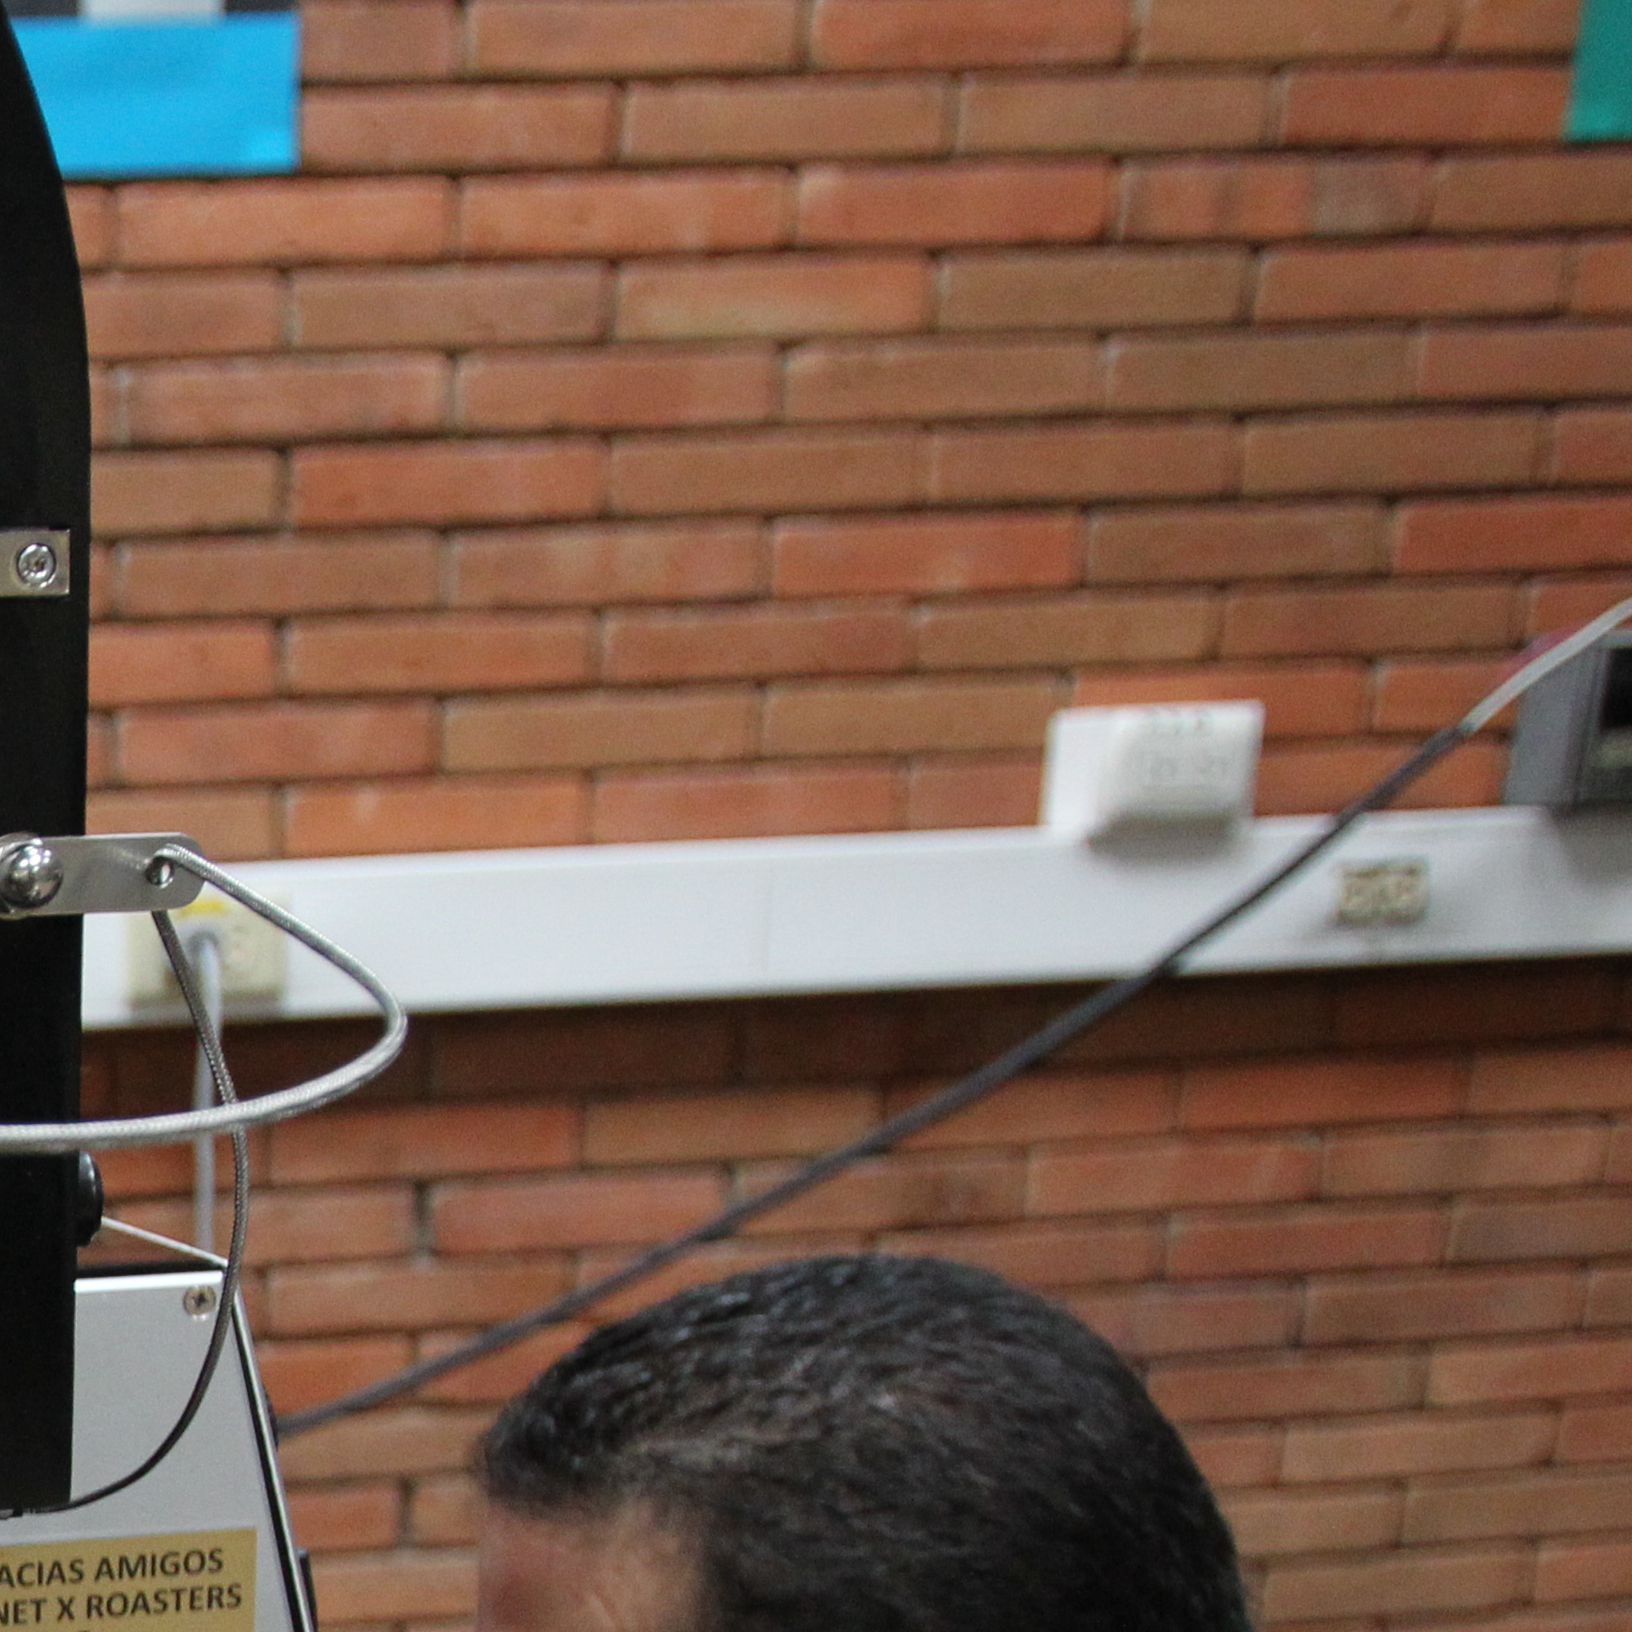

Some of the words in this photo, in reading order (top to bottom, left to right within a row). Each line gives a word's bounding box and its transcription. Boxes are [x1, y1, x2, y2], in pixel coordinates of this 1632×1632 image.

[94, 1548, 224, 1580] AMIGOS
[56, 1596, 76, 1622] X
[86, 1583, 243, 1620] ROASTERS
